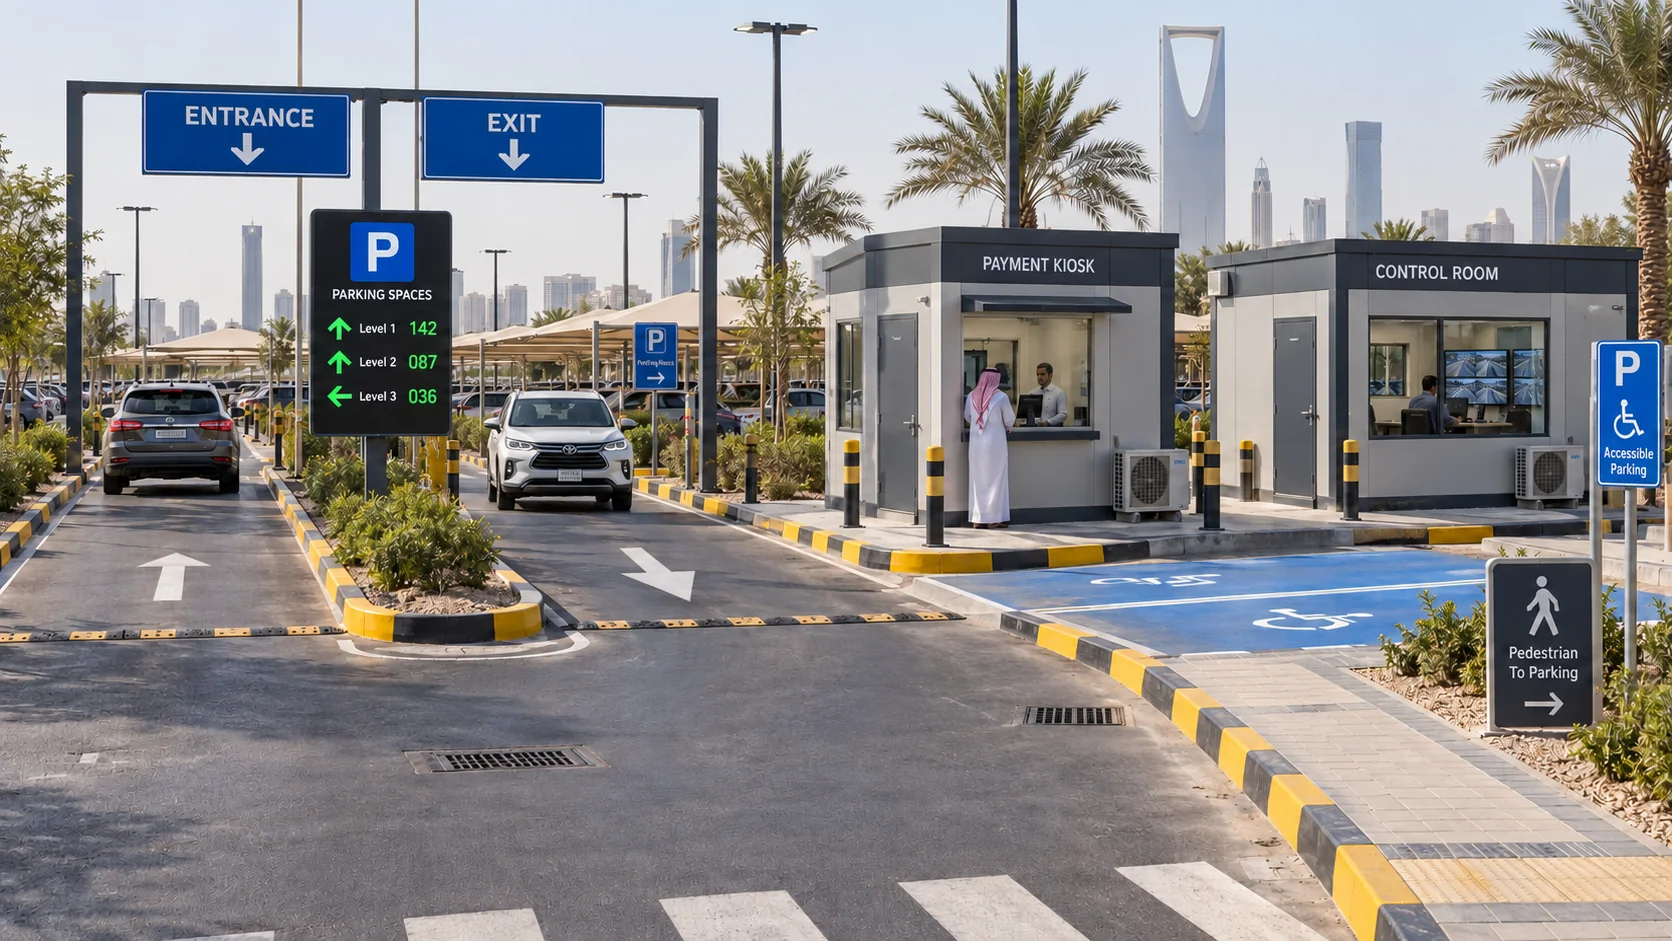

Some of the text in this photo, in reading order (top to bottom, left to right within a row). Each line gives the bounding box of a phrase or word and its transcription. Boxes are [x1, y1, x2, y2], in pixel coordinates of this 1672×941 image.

[185, 105, 315, 128] ENTRANCE
[487, 112, 542, 133] EXIT
[367, 231, 400, 272] P
[983, 256, 1095, 274] PAYMENT KIOSK
[1375, 264, 1499, 281] CONTROL ROOM
[332, 288, 433, 301] PARKING SPACES
[359, 321, 437, 336] Level 1 142
[648, 329, 664, 352] P
[359, 354, 438, 370] Level 2 087
[1615, 350, 1641, 387] P
[359, 388, 437, 405] Level 3 036
[1603, 447, 1654, 460] Accessible
[1610, 463, 1647, 478] Parking
[1509, 646, 1578, 660] Pedestrian
[1509, 665, 1578, 683] To Parking
